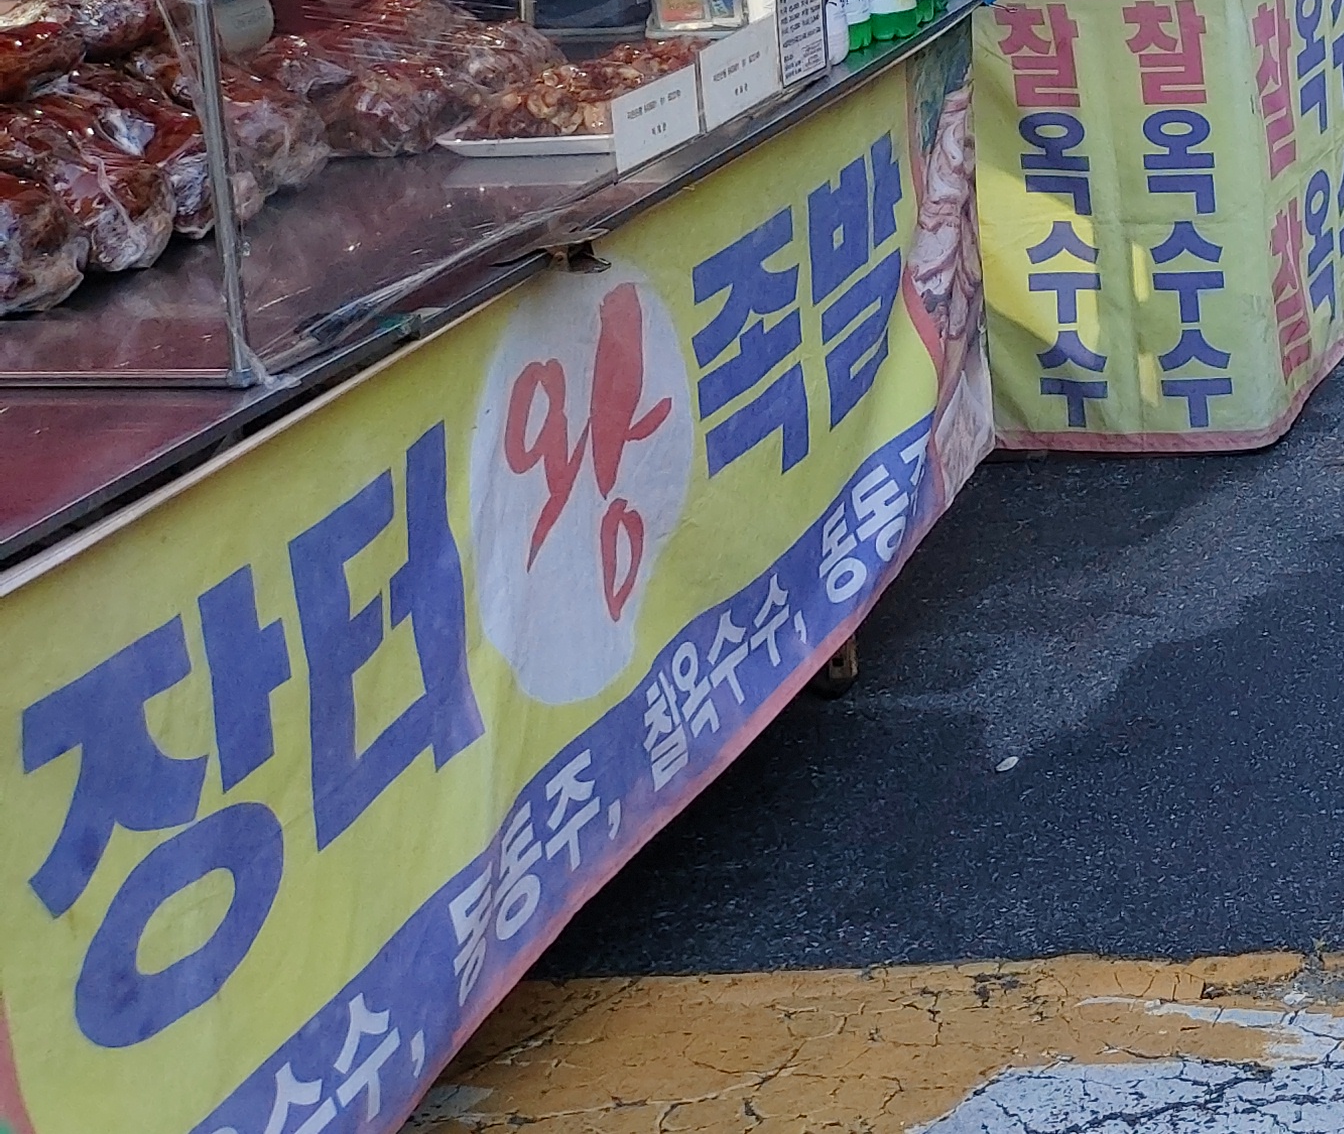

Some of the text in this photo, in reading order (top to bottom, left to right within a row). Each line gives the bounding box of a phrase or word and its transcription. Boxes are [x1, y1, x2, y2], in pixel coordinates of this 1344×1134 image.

[995, 1, 1108, 428] 찰옥수수
[1123, 0, 1234, 428] 찰옥수수
[21, 134, 905, 1049] 장터 왕 족발
[207, 992, 425, 1134] 수수,
[642, 570, 809, 793] 찰옥수수,
